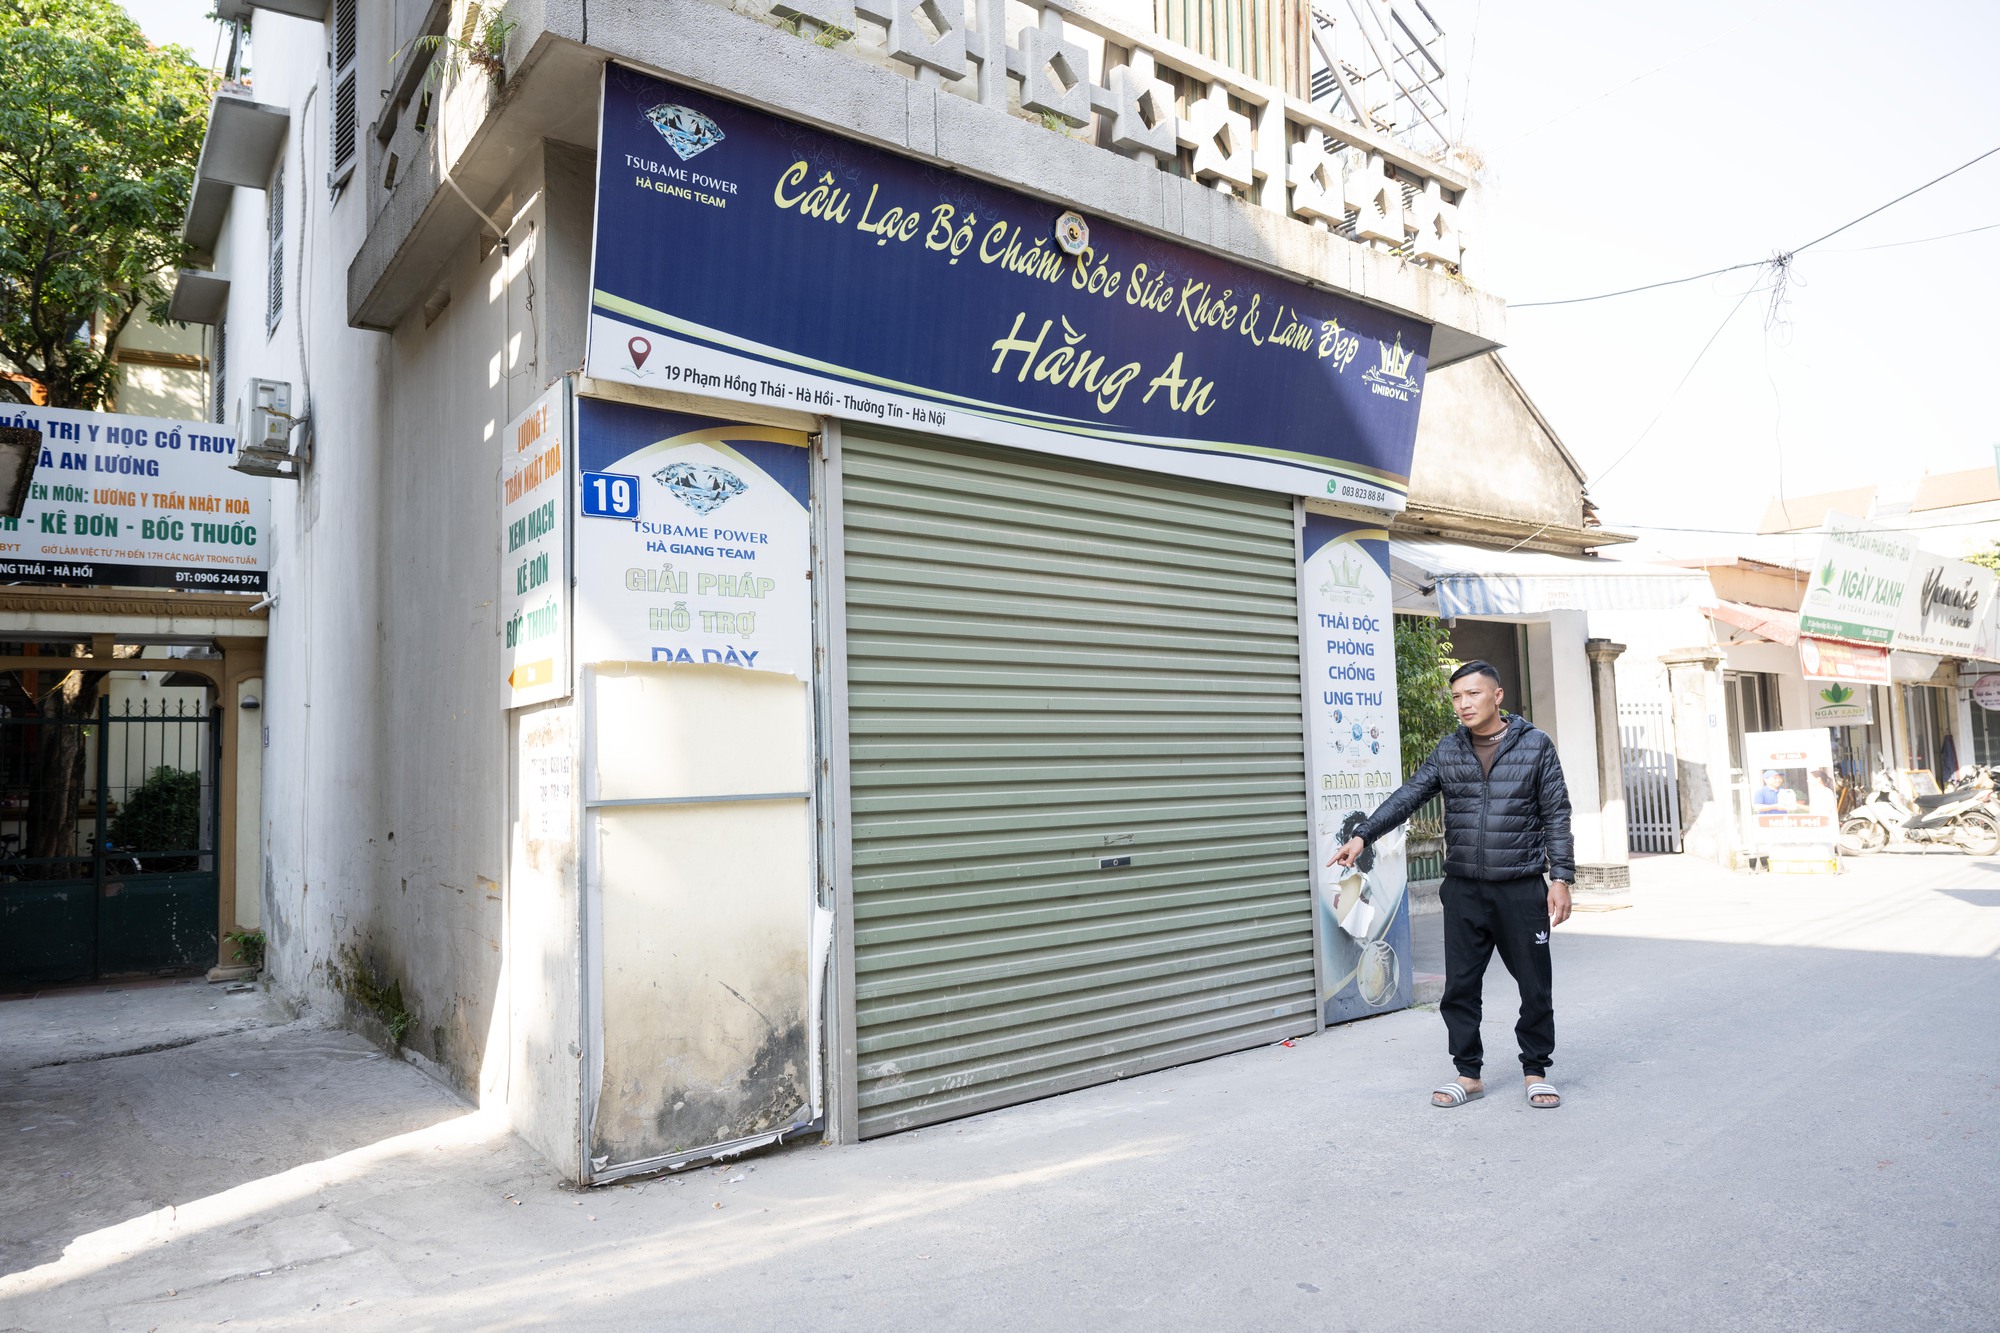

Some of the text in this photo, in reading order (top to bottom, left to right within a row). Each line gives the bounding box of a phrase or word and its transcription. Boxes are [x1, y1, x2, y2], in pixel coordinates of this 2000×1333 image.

[625, 154, 738, 195] TSUBAME POWER
[635, 176, 726, 209] HÀ GIANG TEAM
[774, 160, 850, 224] Câu
[857, 183, 920, 246] Lạc
[925, 203, 978, 265] Bộ
[979, 220, 1066, 283] Chăm
[1071, 246, 1122, 298] Sóc
[1126, 263, 1175, 313] Sức
[1240, 293, 1265, 346] &
[1268, 305, 1315, 352] Làm
[1318, 317, 1360, 373] Đẹp
[991, 311, 1217, 416] Hằng An
[665, 365, 681, 380] 19
[684, 368, 721, 388] Phạm
[724, 374, 757, 397] Hồng
[760, 381, 786, 398] Thái
[796, 387, 812, 402] Hà
[814, 390, 834, 406] Hồi
[844, 395, 885, 418] Thường
[888, 402, 903, 418] Tín
[912, 408, 926, 422] Hà
[929, 410, 946, 427] Nội
[1372, 383, 1409, 402] UNIROYAL
[47, 421, 80, 443] TRỊ
[88, 425, 100, 442] Y
[107, 427, 148, 448] HỌC
[155, 425, 182, 449] CỔ
[188, 434, 236, 454] TRUY
[518, 403, 547, 453] LƯƠNG Y
[60, 452, 87, 470] AN
[95, 454, 159, 476] LƯƠNG
[505, 438, 561, 506] TRẦN NHẬT HOÀ
[53, 484, 88, 503] MÔN:
[94, 488, 137, 507] LƯƠNG
[141, 493, 149, 507] Y
[153, 490, 185, 510] TRẦN
[189, 495, 221, 514] NHẬT
[225, 497, 250, 515] HOÀ
[593, 478, 630, 514] 19
[1342, 486, 1385, 502] 083 823 88 84
[41, 510, 67, 535] KÊ
[74, 513, 118, 537] ĐƠN
[142, 515, 184, 541] BỐC
[191, 520, 257, 546] THUỐC
[509, 499, 554, 554] XEM MẠCH
[634, 521, 768, 544] TSUBAME POWER
[42, 544, 57, 555] GIỜ
[60, 545, 78, 555] LÀM
[80, 548, 98, 558] VIỆC
[115, 550, 126, 558] 7H
[147, 552, 163, 560] 17H
[165, 551, 181, 561] CÁC
[183, 553, 205, 563] NGÀY
[207, 555, 234, 564] TRONG
[646, 540, 756, 560] HÀ GIANG TEAM
[18, 562, 45, 576] THÁI
[54, 564, 70, 577] HÀ
[176, 572, 260, 585] ĐT: 0906 244 974
[517, 551, 549, 596] KÊ ĐƠN
[625, 563, 775, 599] GIẢI PHÁP
[1871, 577, 1905, 608] XANH
[506, 595, 557, 649] BỐC THUỐC
[649, 601, 756, 639] HỖ TRỢ
[1318, 612, 1380, 635] THẢI ĐỘC
[1327, 638, 1375, 656] PHÒNG
[1328, 661, 1376, 682] CHỐNG
[1324, 690, 1383, 706] UNG THƯ
[1321, 794, 1361, 811] KHOA
